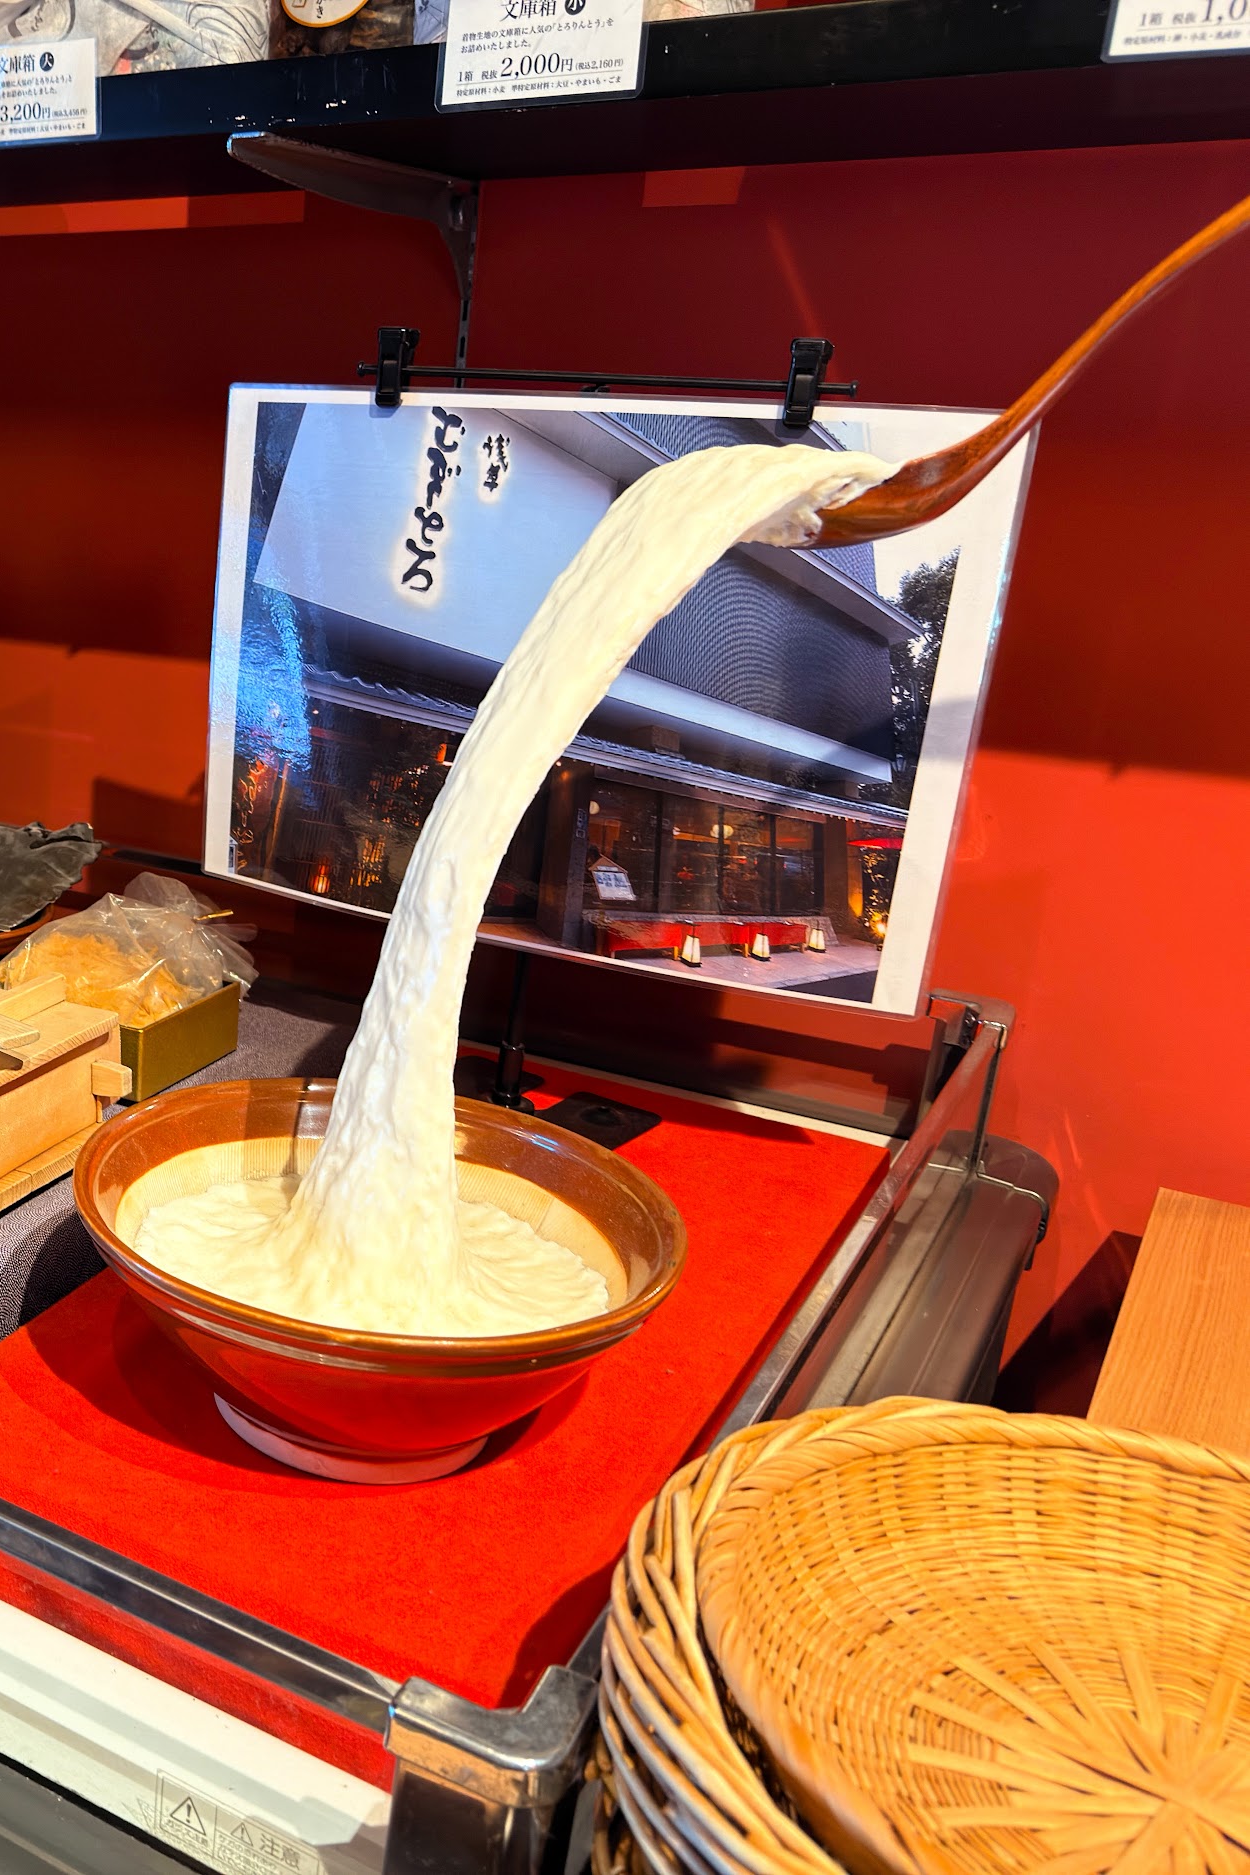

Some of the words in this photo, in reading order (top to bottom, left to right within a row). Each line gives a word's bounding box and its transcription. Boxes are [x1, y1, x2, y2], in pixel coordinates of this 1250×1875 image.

[501, 0, 556, 21] 文庫箱
[500, 52, 573, 79] 2,000円
[260, 1832, 300, 1870] 注意
